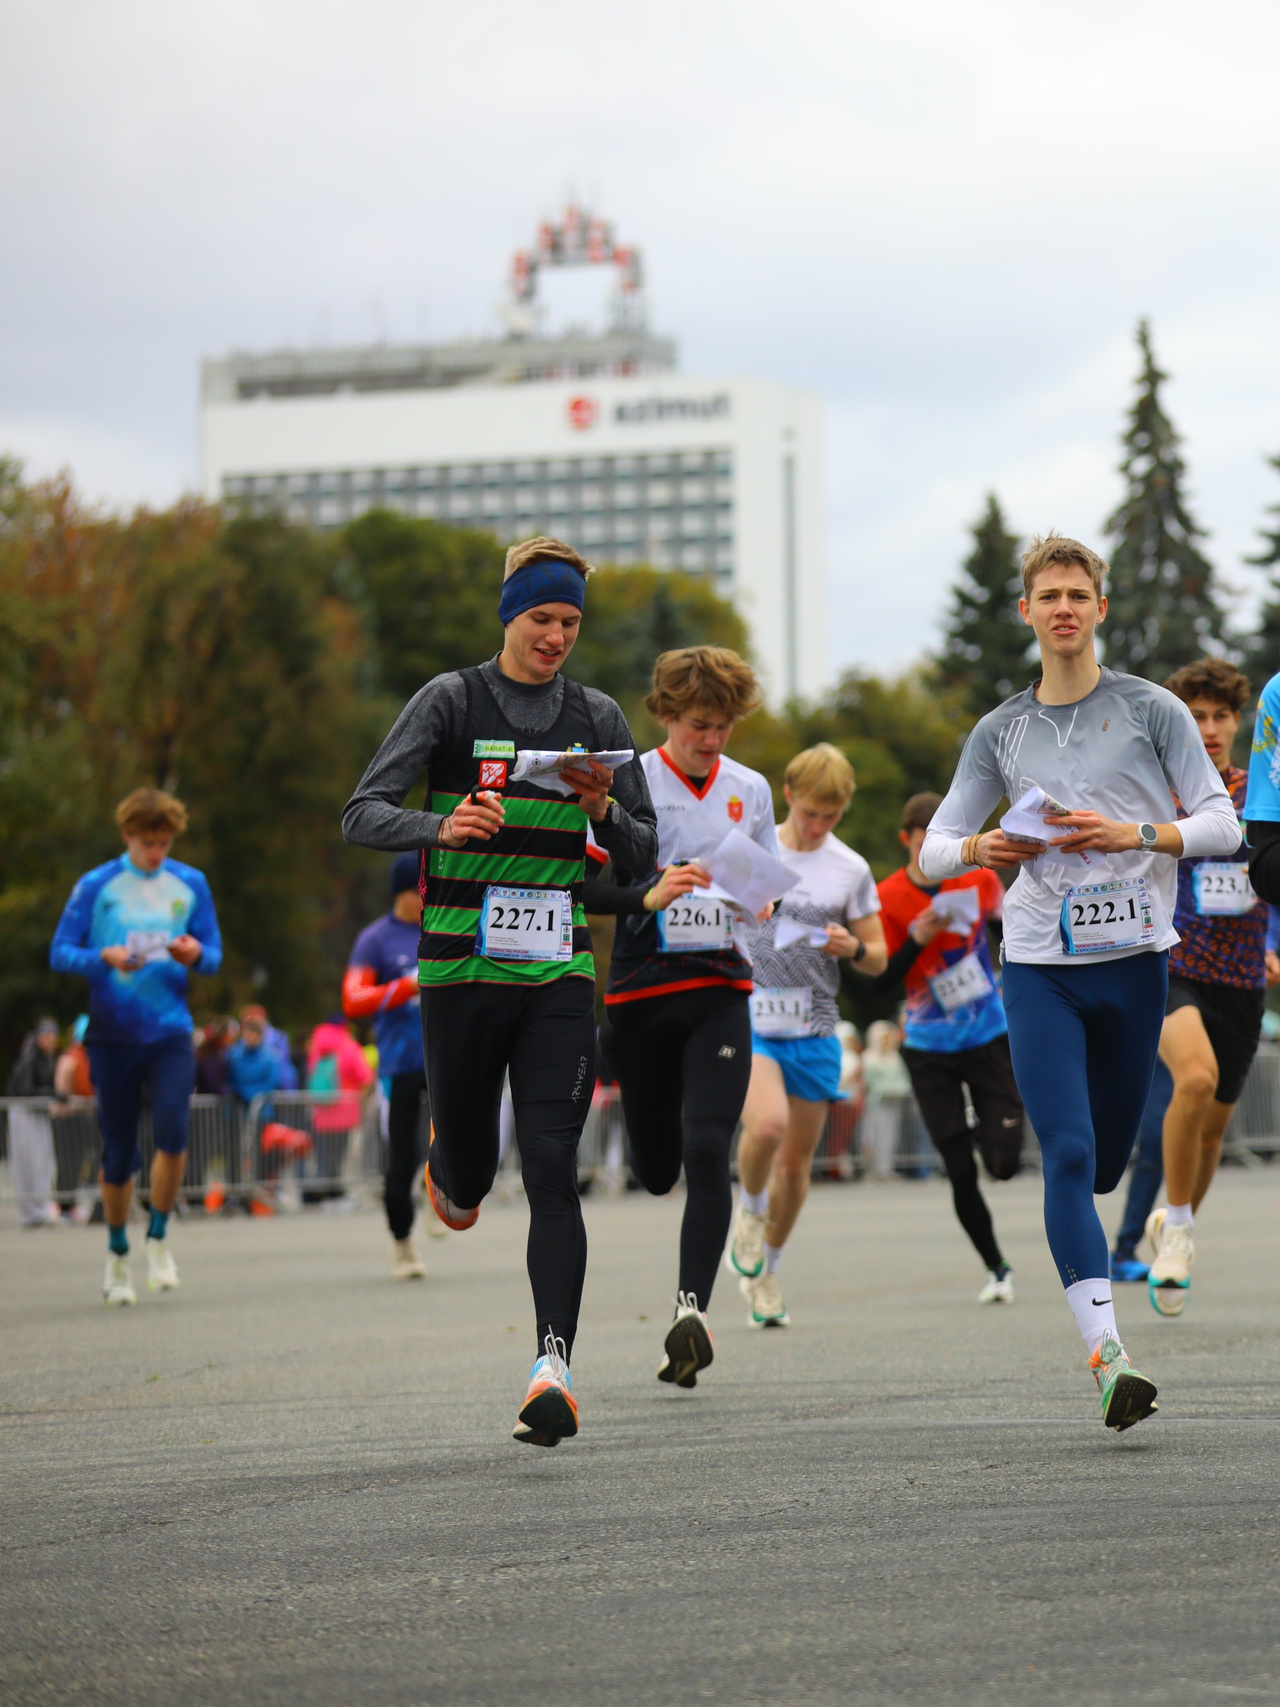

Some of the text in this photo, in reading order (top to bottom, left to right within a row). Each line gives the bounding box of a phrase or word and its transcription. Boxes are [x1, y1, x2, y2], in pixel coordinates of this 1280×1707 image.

[1204, 876, 1249, 893] 223.1
[489, 906, 556, 931] 227.1
[668, 906, 721, 926] 226.1
[1072, 897, 1138, 926] 222.1
[755, 1000, 800, 1017] 233.1
